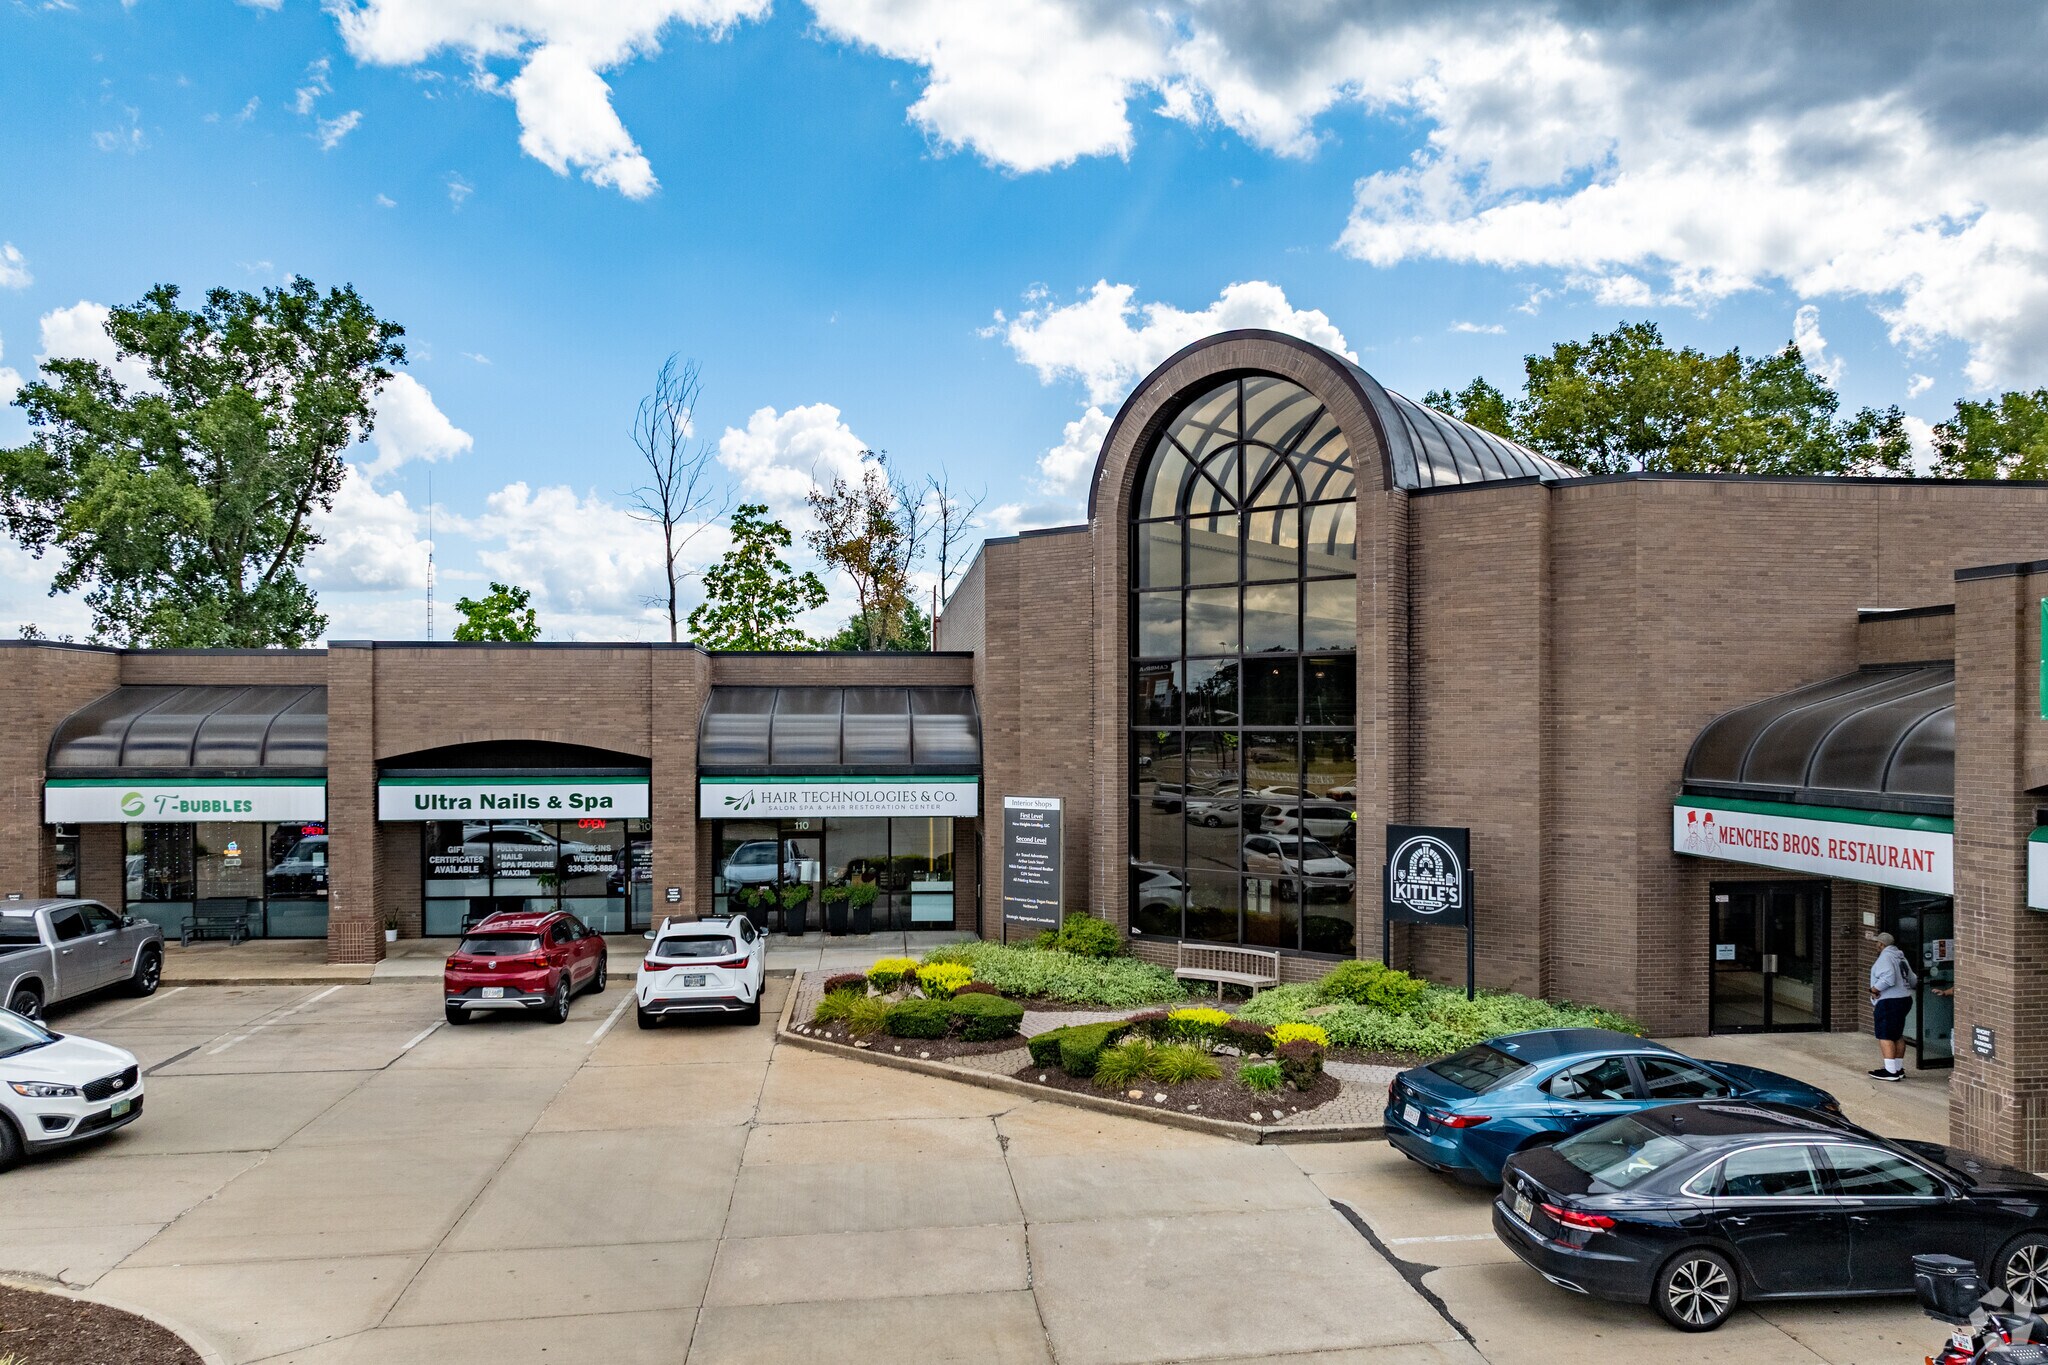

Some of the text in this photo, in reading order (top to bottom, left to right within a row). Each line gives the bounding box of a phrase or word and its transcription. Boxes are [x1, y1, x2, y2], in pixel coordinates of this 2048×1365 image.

[761, 791, 797, 803] HAIR
[801, 790, 917, 802] TECHNOLOGIES
[920, 790, 931, 802] &
[414, 792, 613, 812] Ultra Nails & Spa
[1011, 799, 1052, 808] Interior Shops
[577, 818, 606, 829] OPEN
[794, 821, 809, 830] 110
[301, 826, 324, 835] OPEN
[447, 846, 465, 854] GIFT
[1718, 826, 1935, 873] MENCHES BROS. RESTAURANT
[429, 856, 484, 864] CERTIFICATES
[434, 865, 479, 874] AVAILABLE
[501, 869, 531, 877] WAXING
[1395, 883, 1458, 903] KITTLE'S
[1975, 1027, 1991, 1037] SHORT
[1977, 1034, 1989, 1042] TERM
[1974, 1039, 1993, 1049] PARKING
[1977, 1046, 1989, 1054] ONLY
